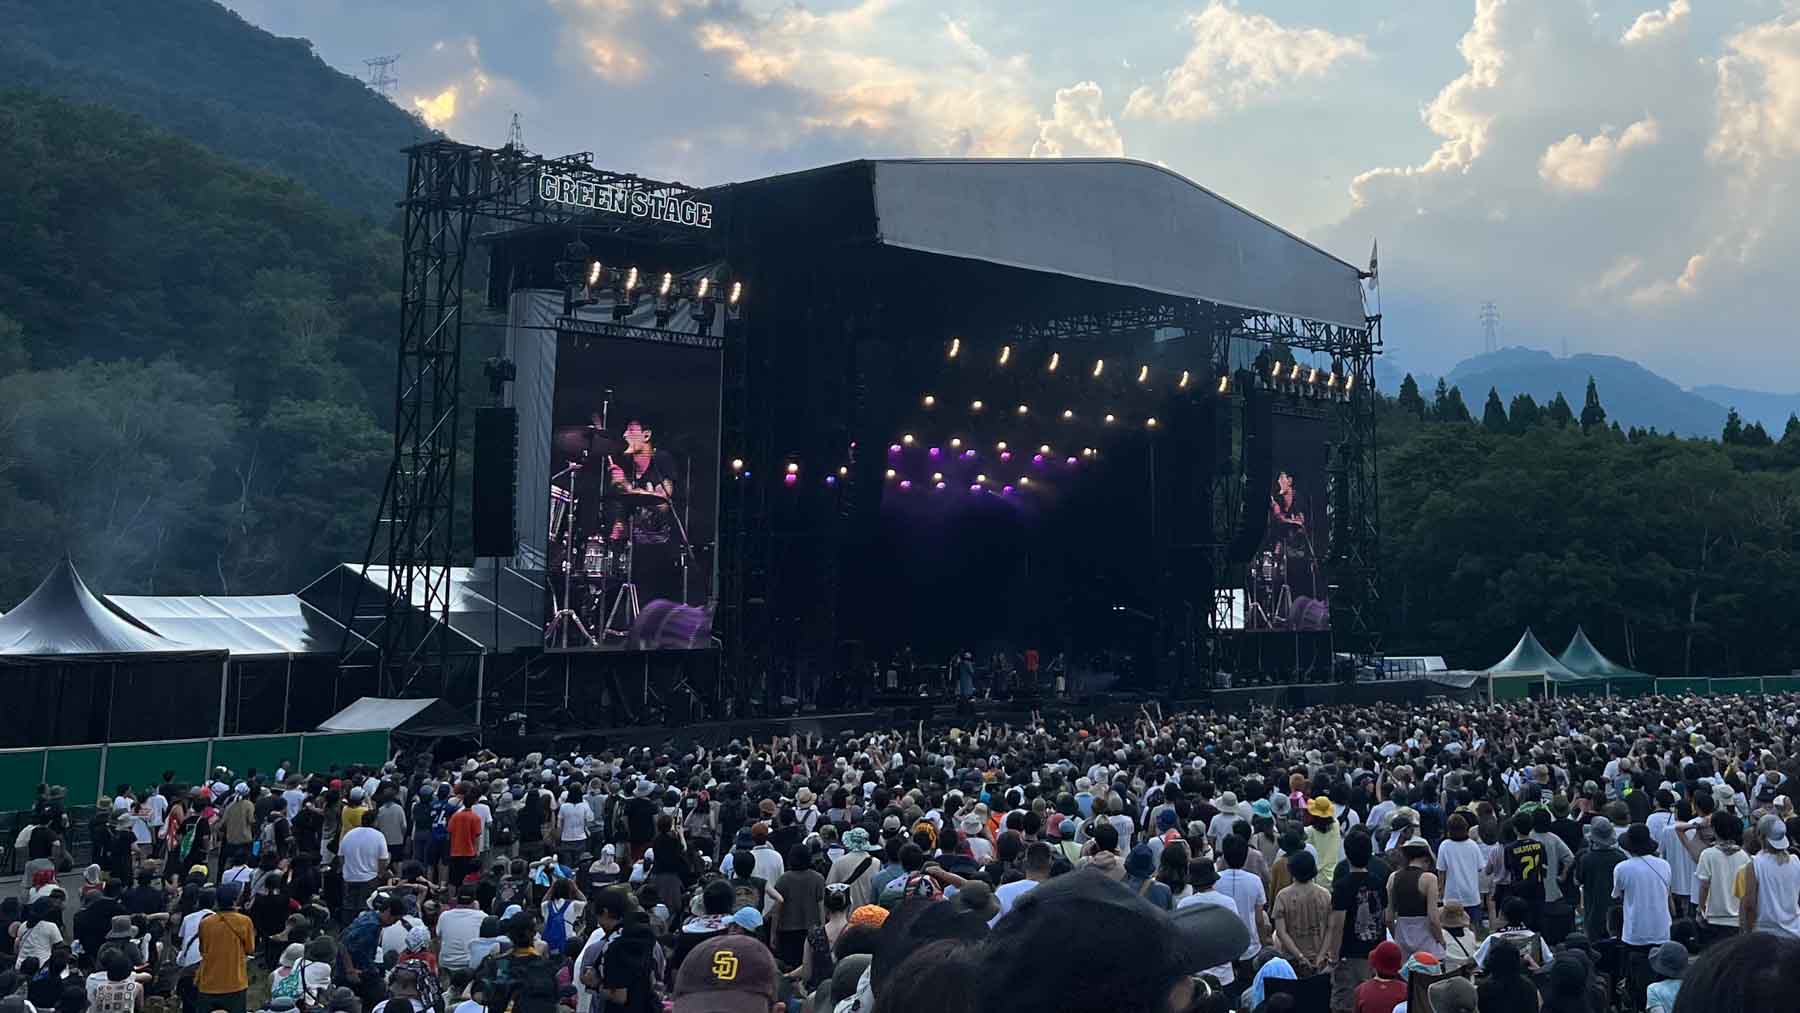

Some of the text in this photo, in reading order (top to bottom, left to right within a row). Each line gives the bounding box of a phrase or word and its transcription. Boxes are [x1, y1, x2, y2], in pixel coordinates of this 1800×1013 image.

[540, 174, 713, 228] GREEN STAGE
[712, 951, 738, 980] SD
